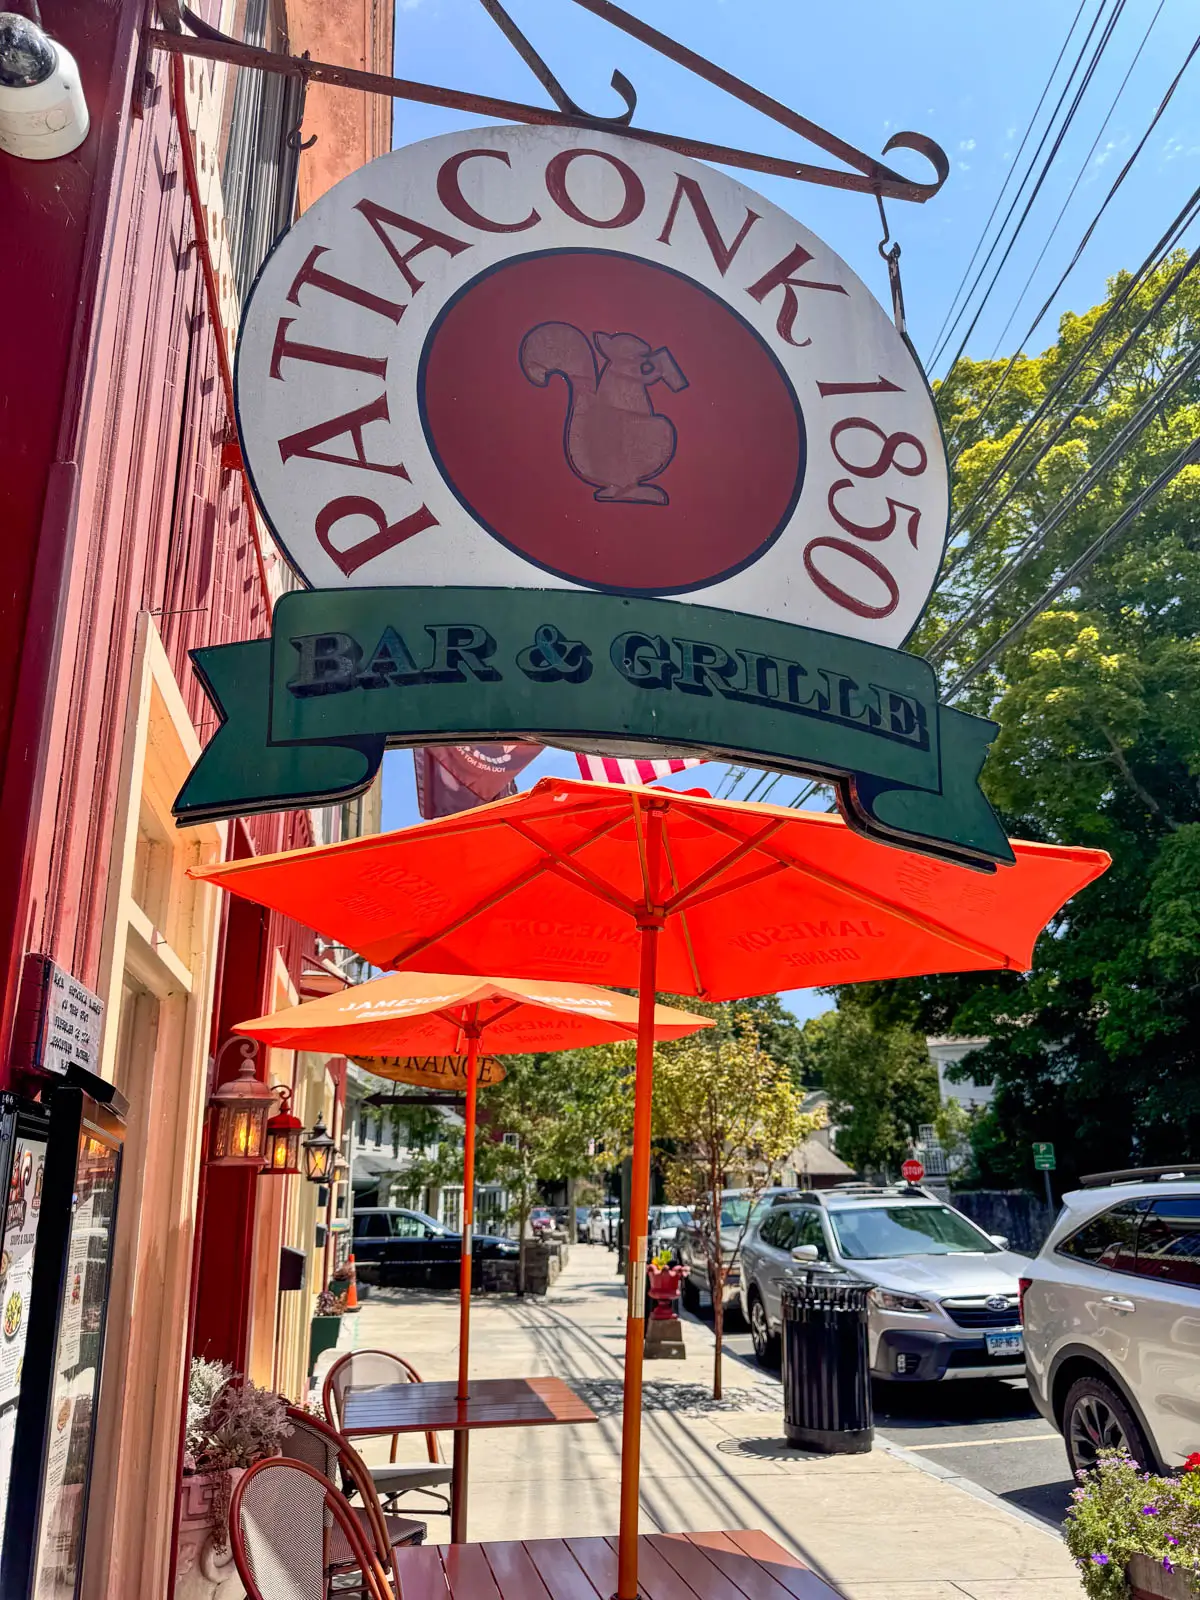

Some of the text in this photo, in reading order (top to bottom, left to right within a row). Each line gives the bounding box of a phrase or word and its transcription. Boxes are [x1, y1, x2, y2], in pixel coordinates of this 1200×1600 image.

[270, 148, 928, 620] PATTACONK 1850
[288, 623, 931, 752] BAR & GRILLE
[902, 1166, 923, 1177] STOP
